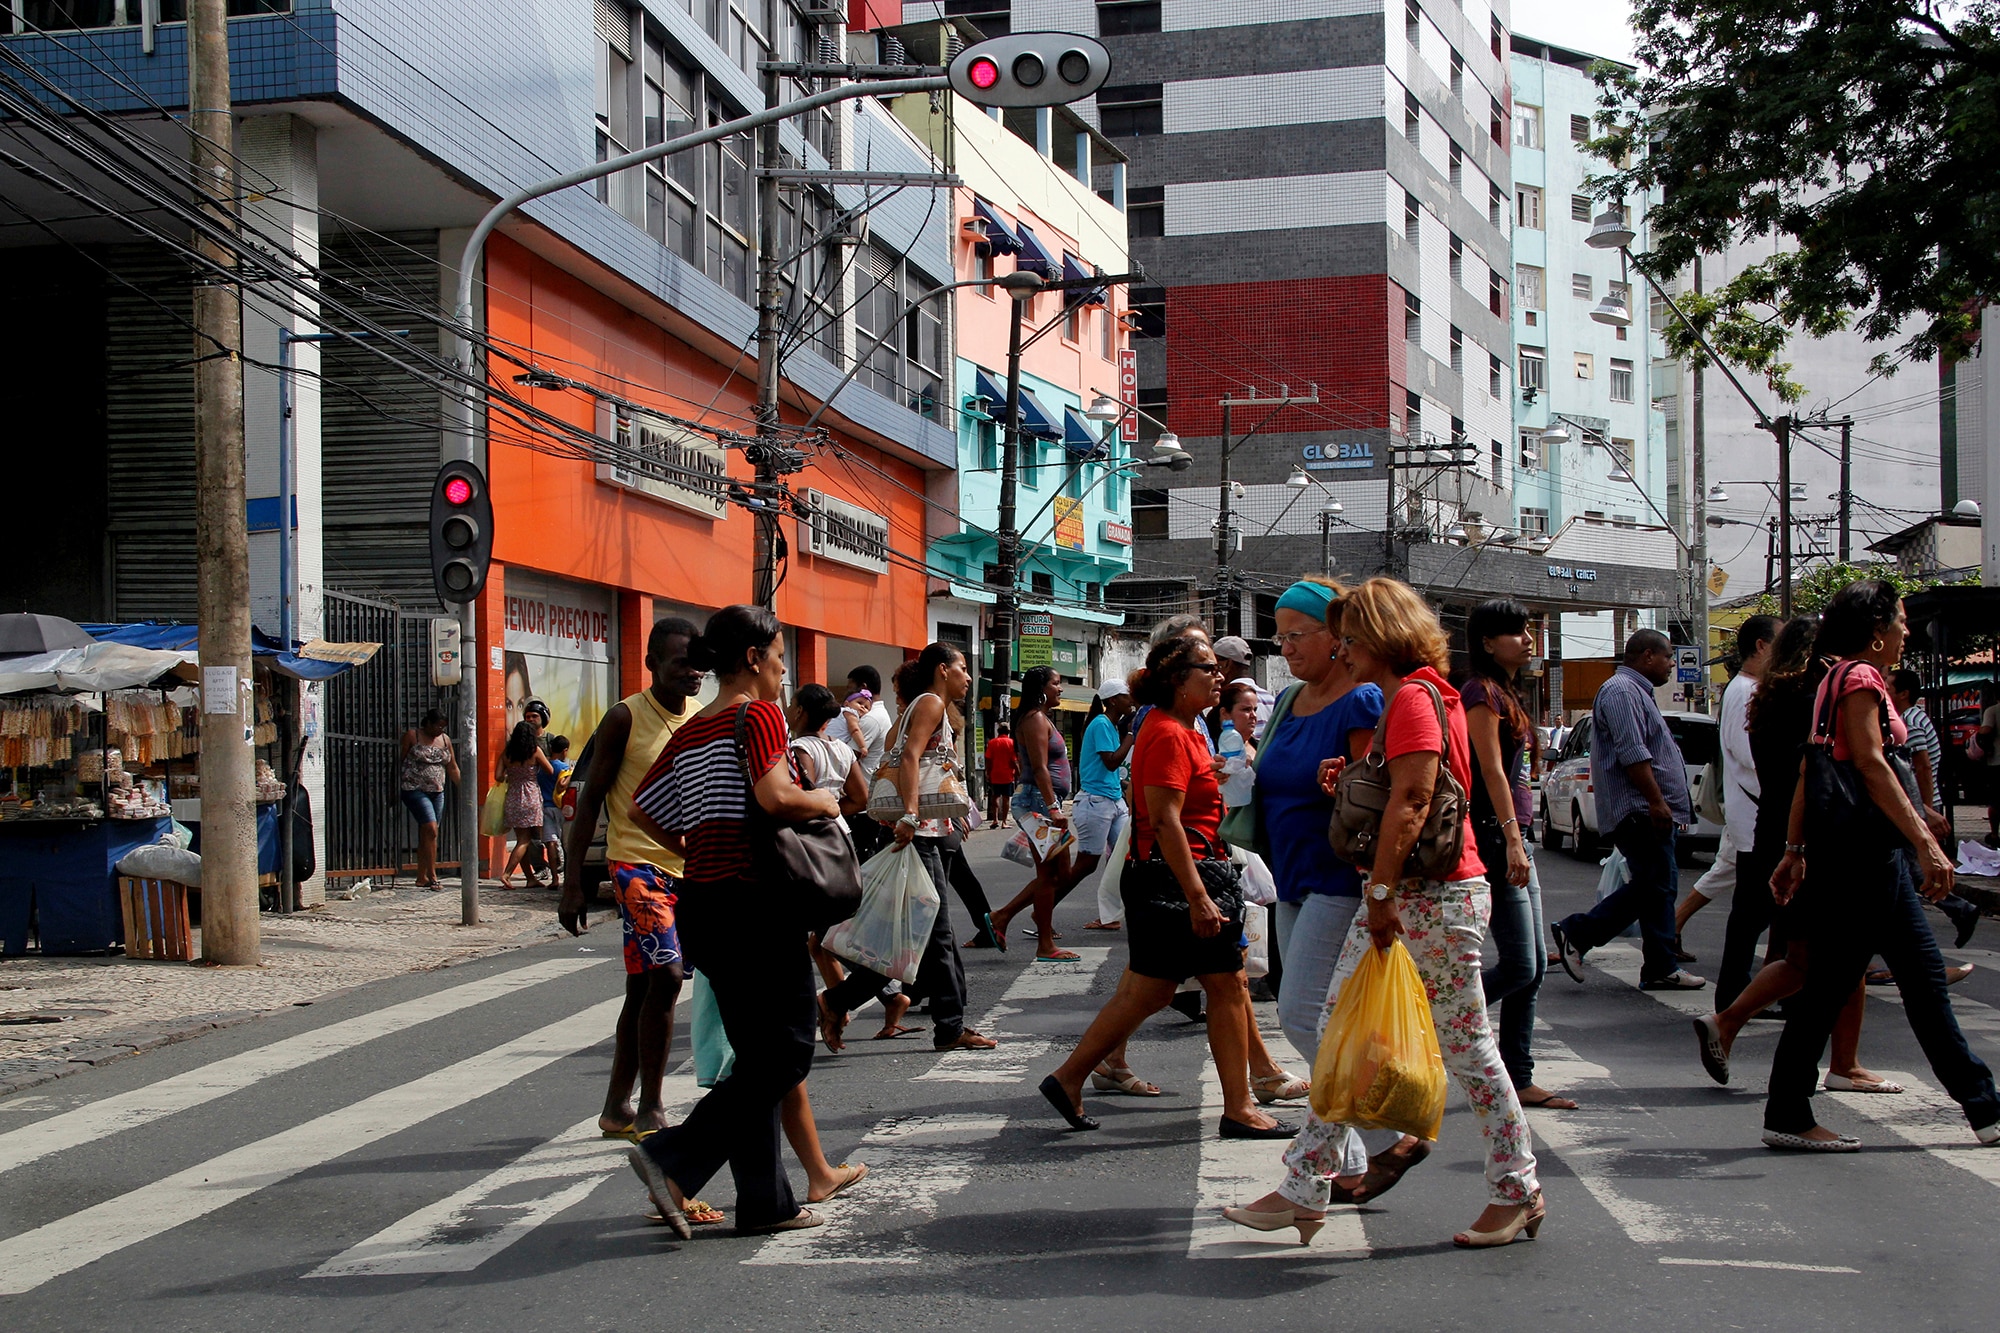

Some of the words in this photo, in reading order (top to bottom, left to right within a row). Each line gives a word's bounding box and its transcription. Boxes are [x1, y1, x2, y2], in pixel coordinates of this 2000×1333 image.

[1020, 614, 1052, 624] NATURAL
[549, 604, 590, 650] PREÇO
[592, 611, 608, 643] DE
[1022, 625, 1051, 635] CENTER
